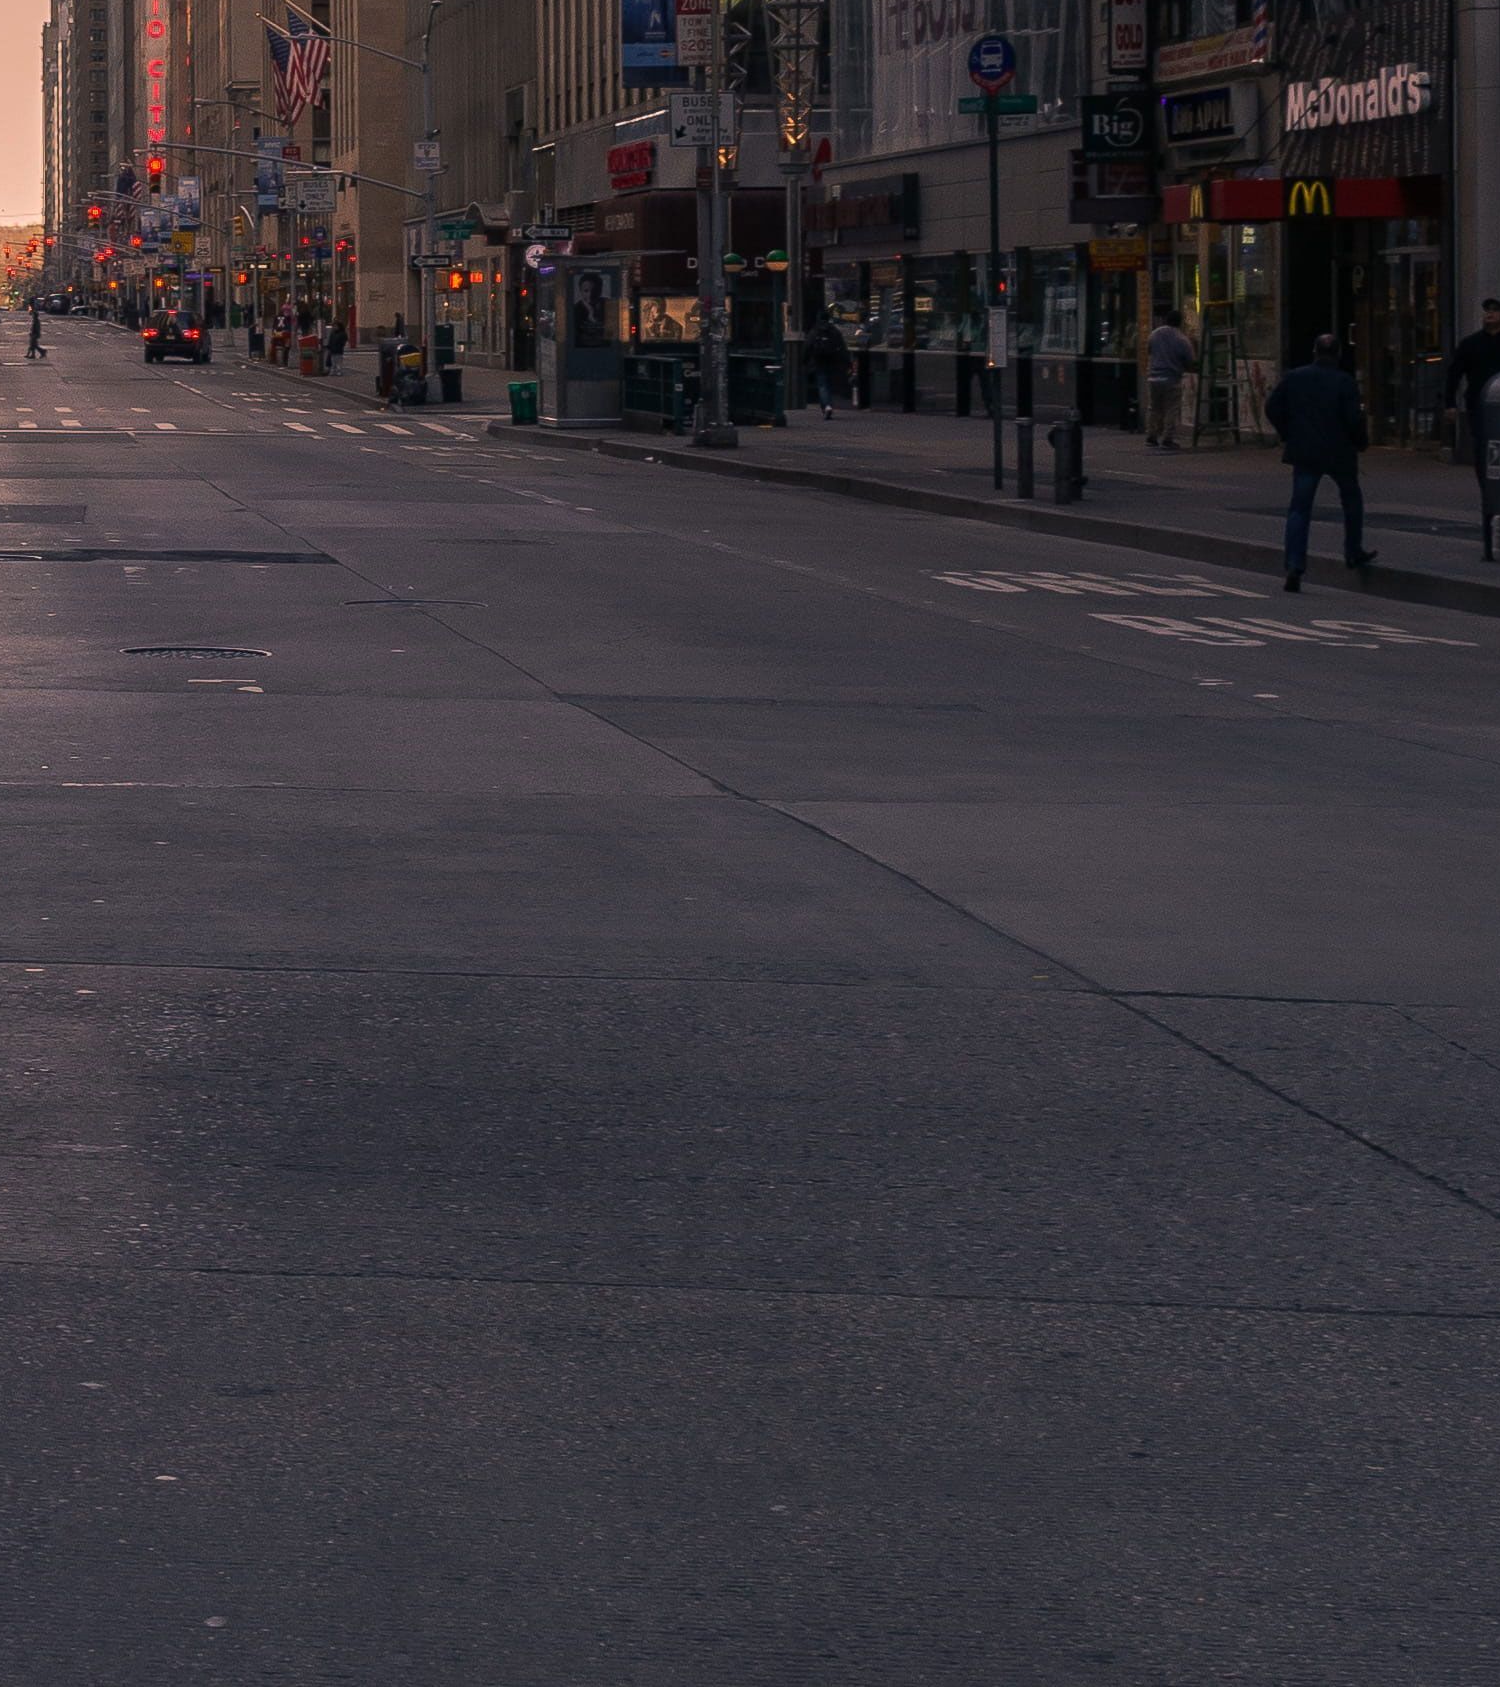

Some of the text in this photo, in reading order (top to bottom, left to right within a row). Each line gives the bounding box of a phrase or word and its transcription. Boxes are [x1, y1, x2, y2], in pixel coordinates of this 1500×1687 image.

[1115, 23, 1144, 51] GOLD
[147, 60, 167, 143] CITY
[1285, 63, 1431, 133] McDonald's
[1092, 113, 1135, 137] Big
